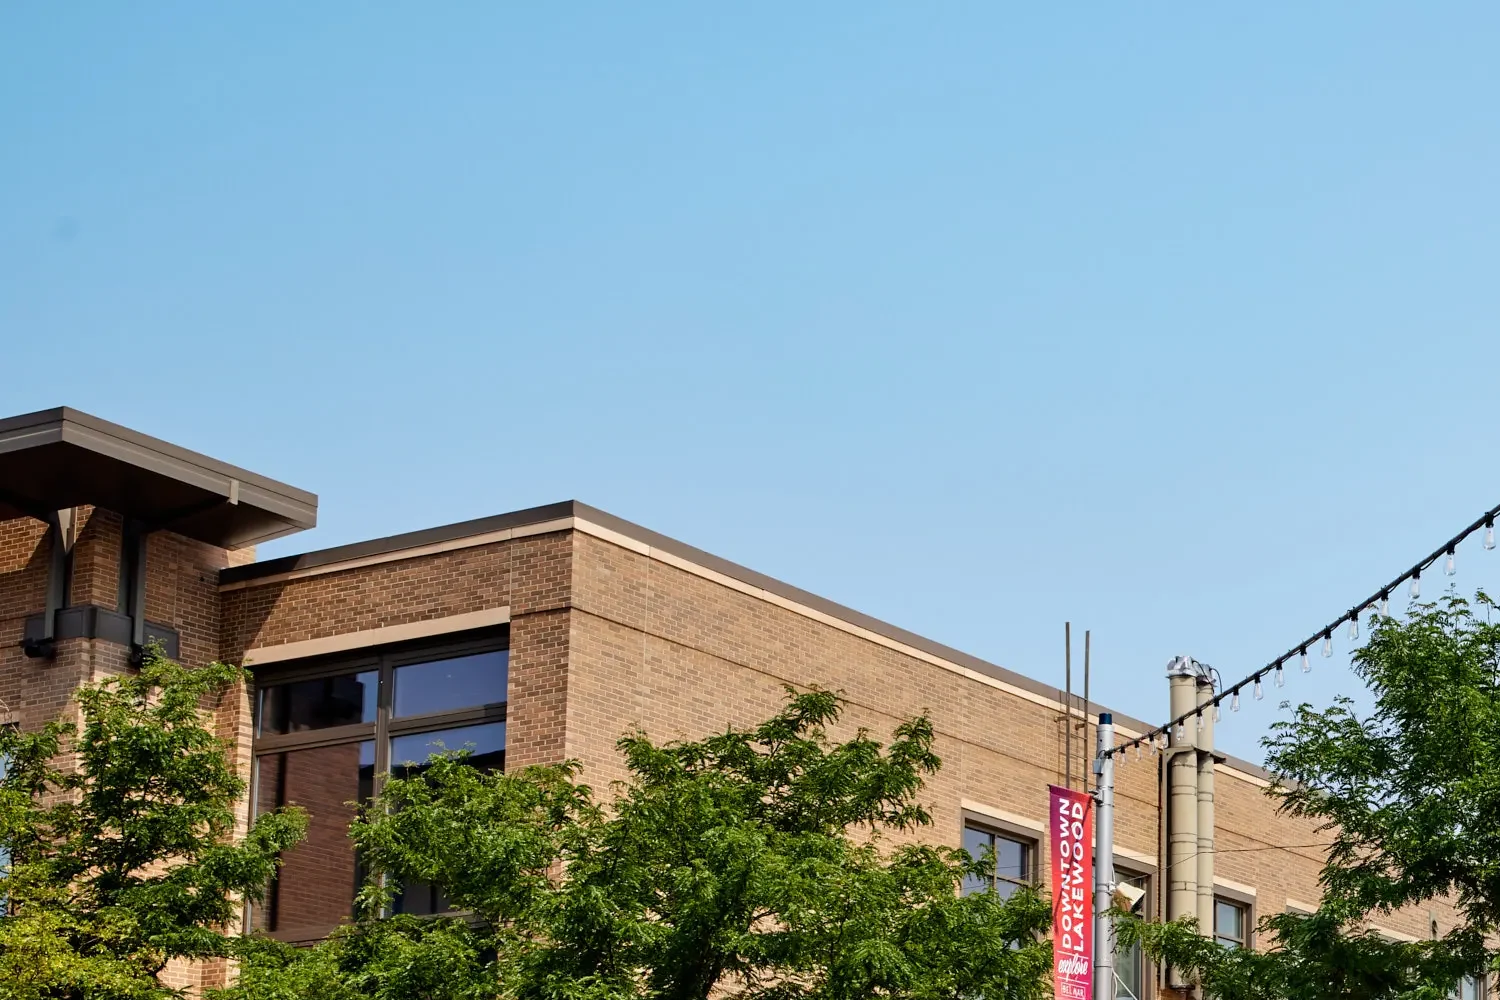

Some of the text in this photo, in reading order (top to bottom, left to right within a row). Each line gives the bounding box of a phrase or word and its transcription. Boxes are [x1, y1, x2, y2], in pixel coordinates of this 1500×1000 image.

[1059, 798, 1072, 949] DOWNTOWN
[1071, 802, 1084, 952] LAKEWOOD
[1058, 953, 1088, 982] explore
